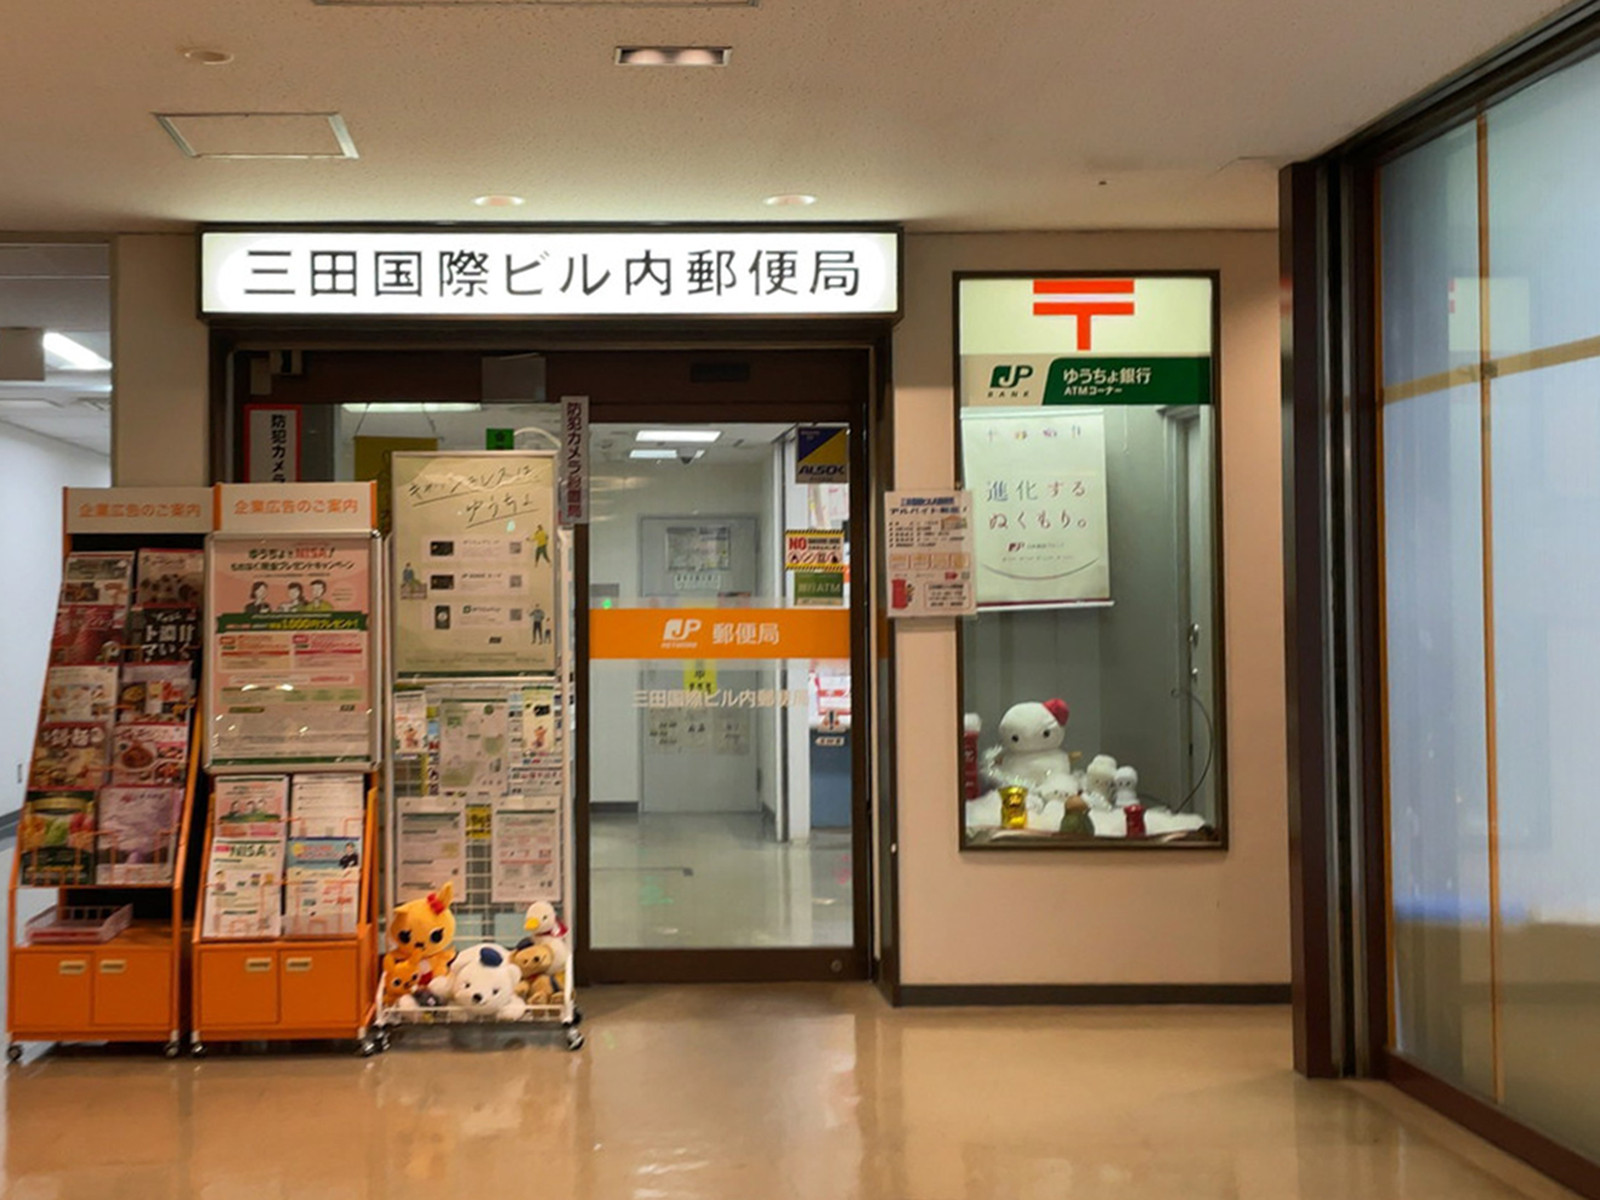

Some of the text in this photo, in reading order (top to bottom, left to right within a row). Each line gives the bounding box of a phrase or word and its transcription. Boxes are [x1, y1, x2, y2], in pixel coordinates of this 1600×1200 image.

[243, 249, 860, 298] 三田国際ビル内郵便局
[989, 365, 1034, 389] JP
[1063, 366, 1152, 385] ゆうちょ銀行
[1064, 386, 1123, 396] ATMコーナー
[798, 464, 845, 475] ALSOK
[986, 479, 1086, 502] 進化する
[78, 503, 200, 518] 企業広告のご案内
[234, 499, 359, 516] 企業広告のご案内
[465, 491, 533, 523] ゆうちょ
[988, 509, 1087, 530] ぬくもり。
[662, 618, 702, 641] JP
[712, 622, 780, 645] 郵便局
